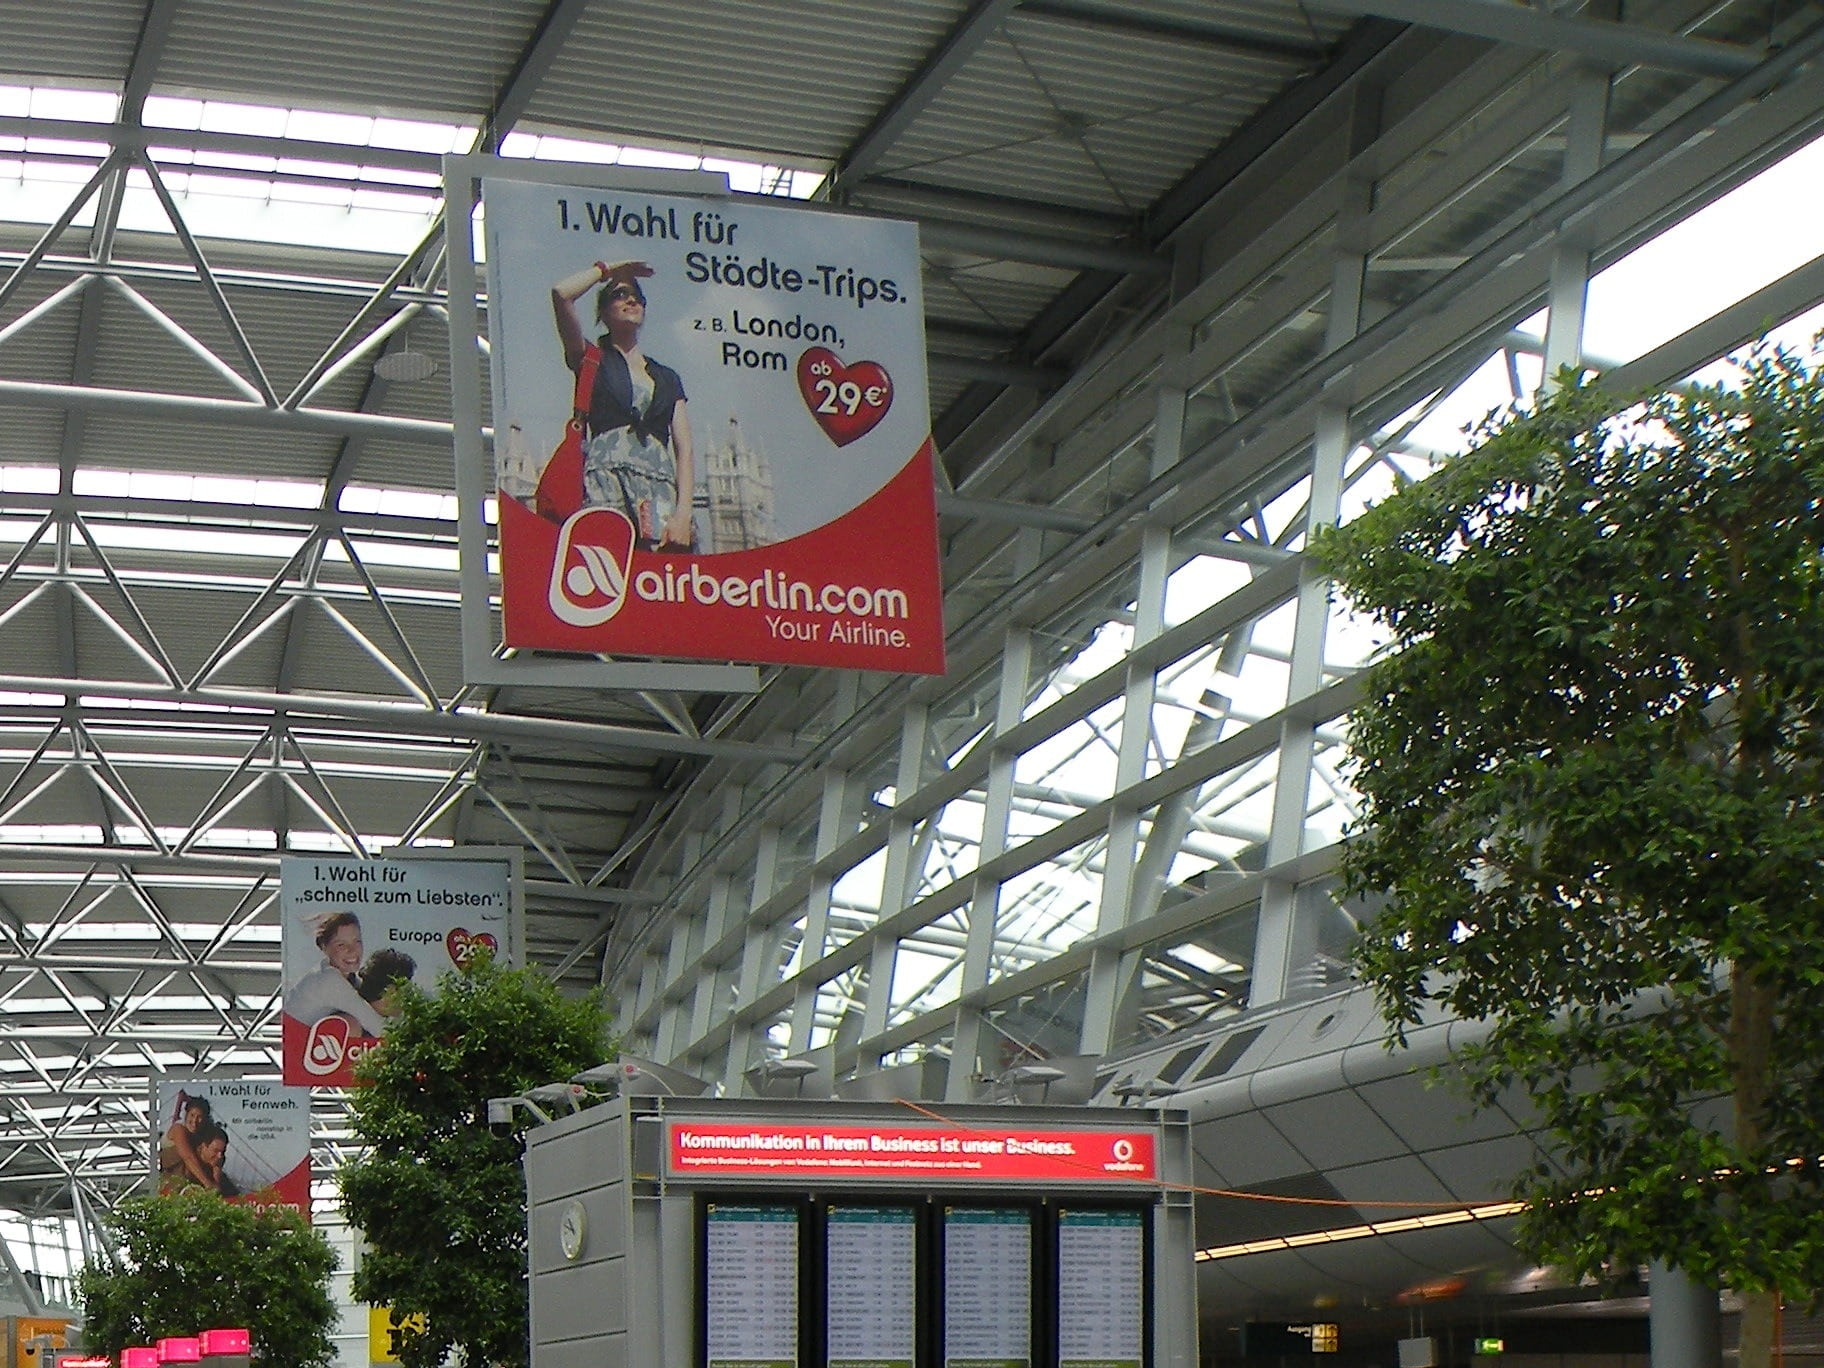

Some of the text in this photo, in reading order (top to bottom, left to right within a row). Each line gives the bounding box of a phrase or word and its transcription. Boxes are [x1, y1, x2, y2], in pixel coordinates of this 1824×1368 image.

[557, 199, 739, 246] 1. Wahl für
[685, 251, 908, 308] Städte-Trips.
[693, 309, 846, 349] z. B. London,
[721, 341, 788, 372] Rom
[810, 359, 833, 377] ab
[634, 562, 909, 620] airberlin.com
[764, 614, 912, 649] Your Airline.
[313, 865, 407, 883] 1. Wahl für
[373, 890, 412, 904] zum
[388, 928, 443, 945] Europa
[209, 1084, 272, 1096] 1. Wahl für
[241, 1098, 299, 1110] Fernweh.
[679, 1131, 1076, 1155] Kommunikation in Ihrem Business ist unser Business.
